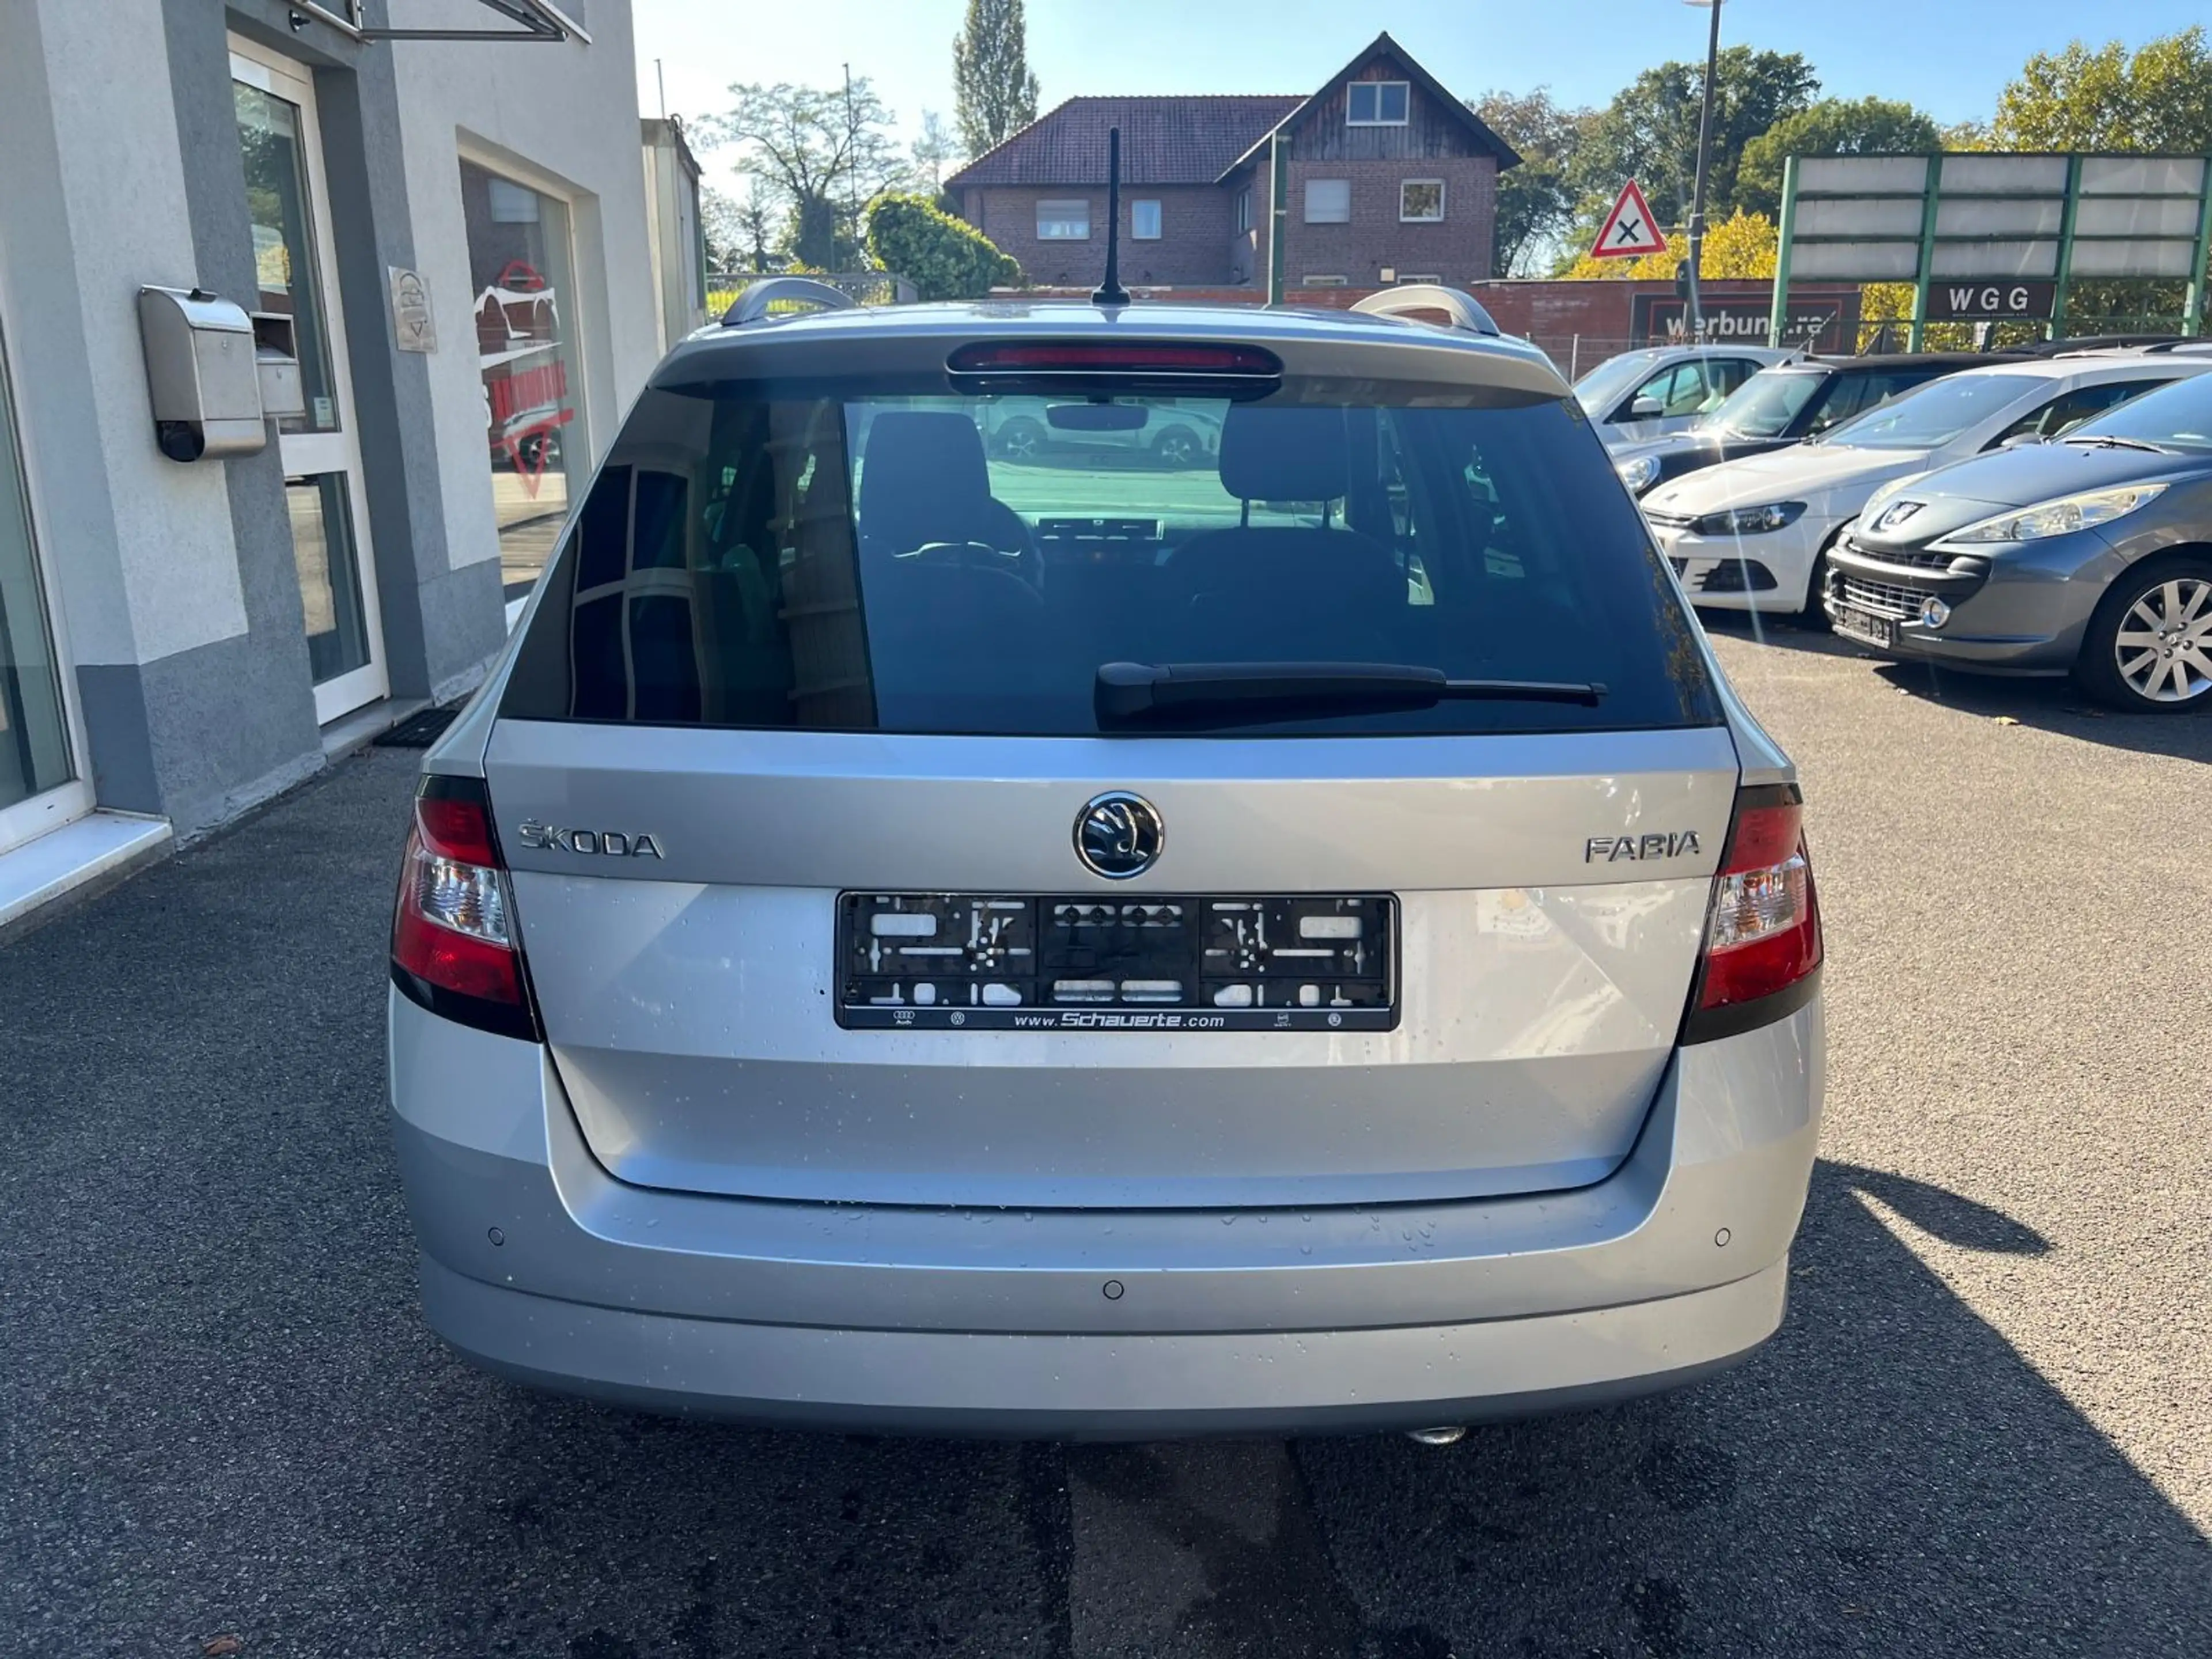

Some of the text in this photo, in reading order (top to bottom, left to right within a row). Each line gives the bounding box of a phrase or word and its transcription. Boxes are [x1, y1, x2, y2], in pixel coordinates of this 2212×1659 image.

[1666, 310, 1823, 336] werbun.re
[518, 818, 666, 860] ŠKODA
[1585, 830, 1700, 863] FABIA
[1014, 1013, 1224, 1027] www.Schauerte.com
